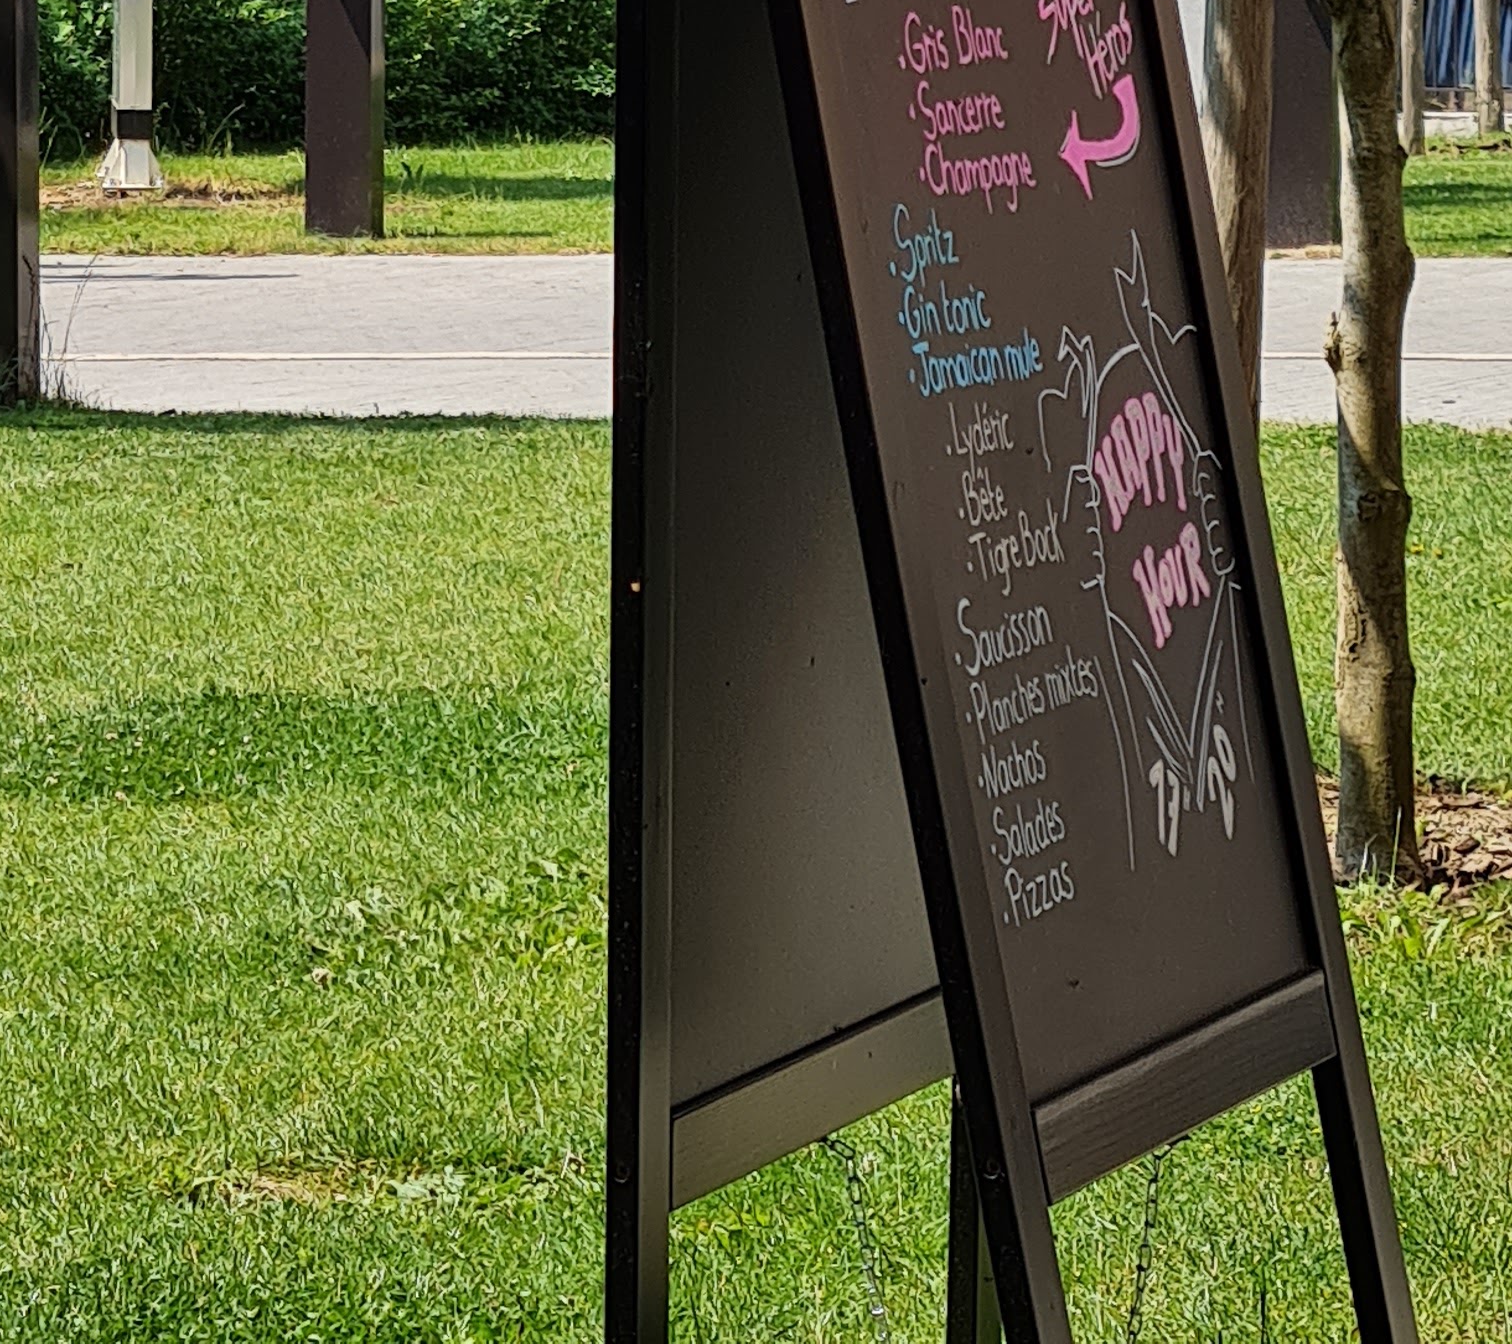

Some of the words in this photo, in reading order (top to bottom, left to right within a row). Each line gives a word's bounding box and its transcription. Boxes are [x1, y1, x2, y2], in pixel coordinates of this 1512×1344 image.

[904, 12, 950, 74] Gris
[951, 4, 1009, 65] Blanc
[917, 80, 1005, 141] Sancerre
[924, 141, 1037, 214] Champagne
[893, 203, 960, 288] Spritz
[904, 285, 942, 339] Gin
[940, 279, 992, 334] tonic
[911, 340, 1005, 397] Jamaican
[1003, 326, 1044, 382] mule
[962, 466, 1008, 527] Bête
[1094, 391, 1187, 533] HAPPY
[968, 531, 1023, 597] Tigre
[1018, 509, 1066, 568] Bock
[1132, 522, 1211, 650] HOUR
[956, 597, 1054, 677] Saucisson
[969, 673, 1046, 745] Planches
[1044, 644, 1099, 711] mixtes
[980, 739, 1047, 800] Nachos
[992, 798, 1066, 866] Salades
[1004, 861, 1076, 928] Pizzas
